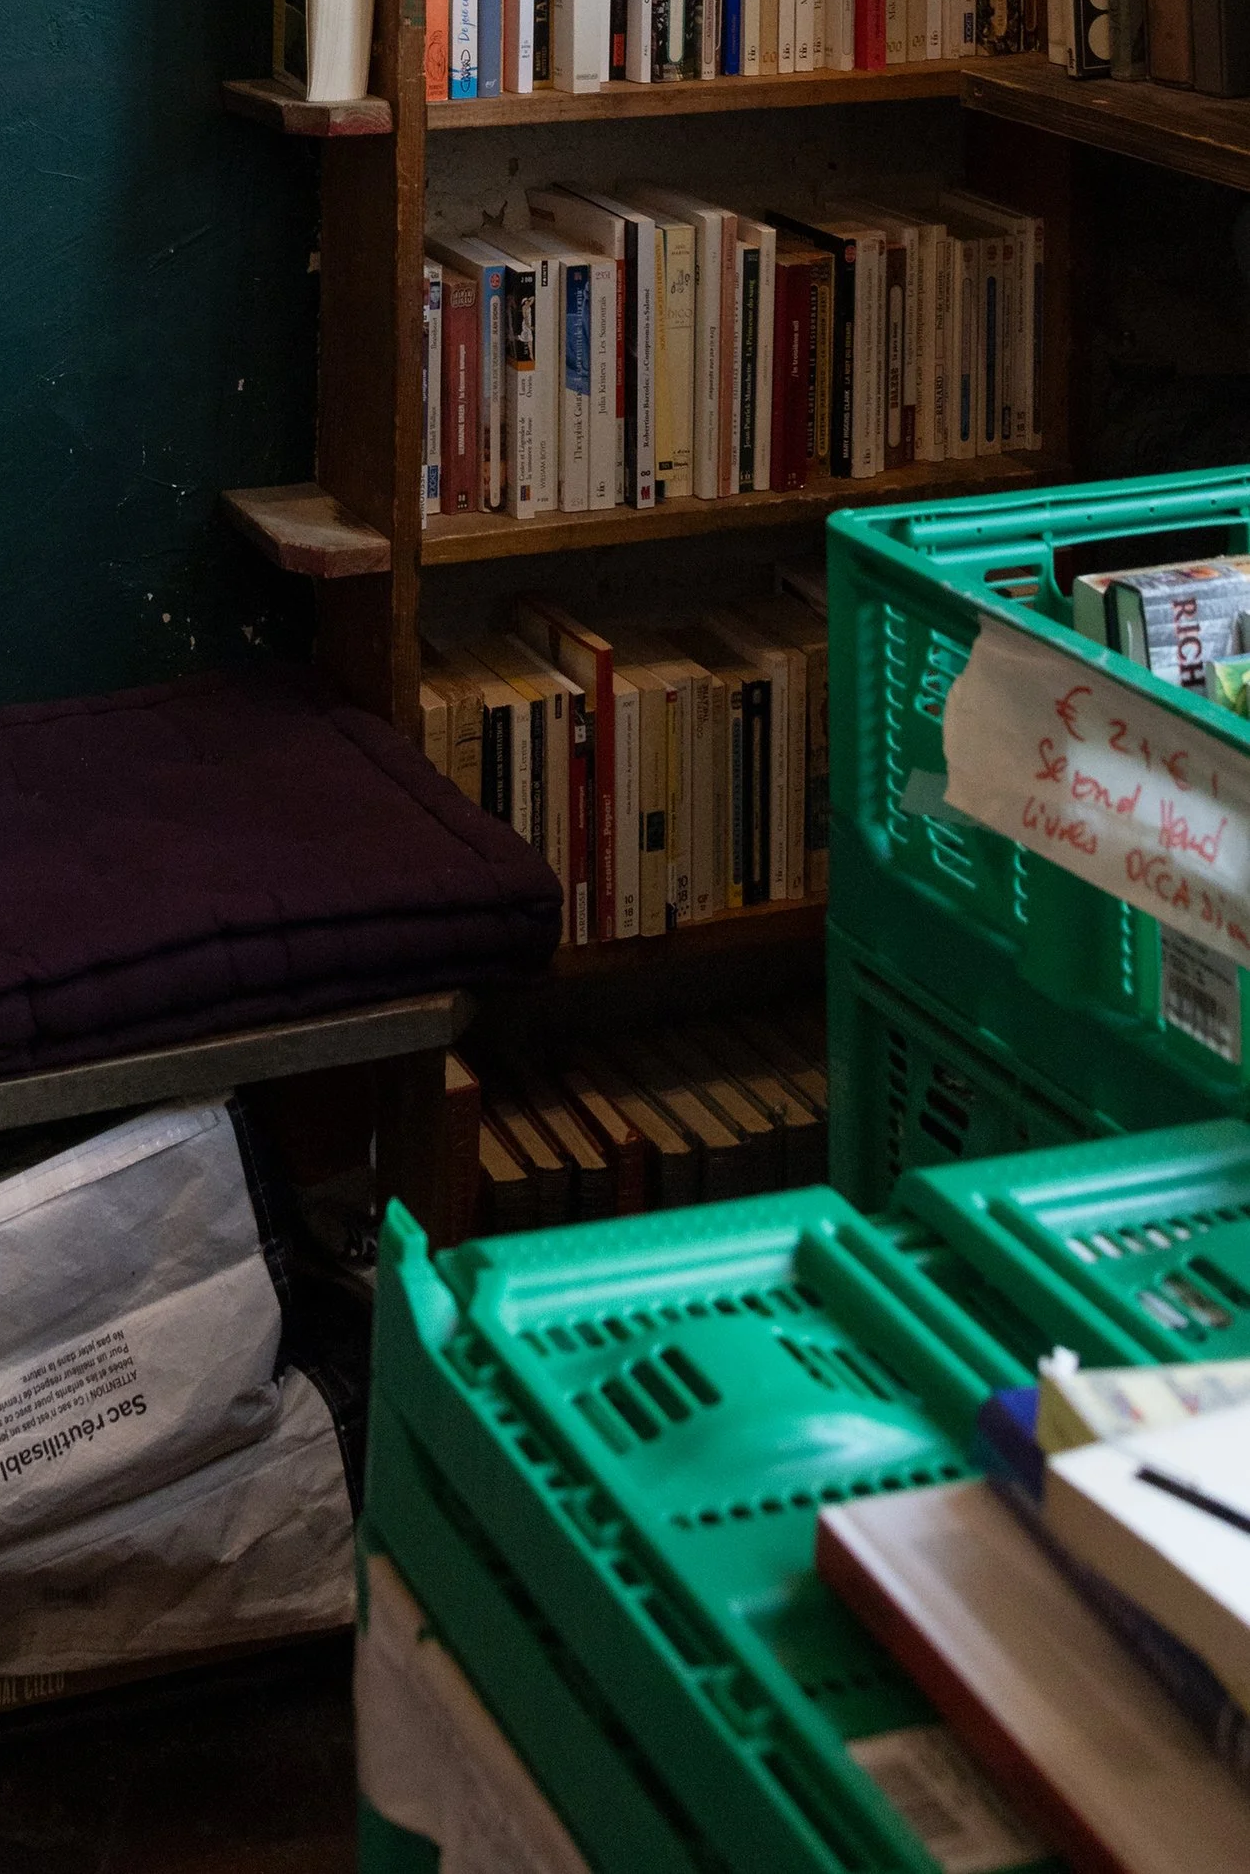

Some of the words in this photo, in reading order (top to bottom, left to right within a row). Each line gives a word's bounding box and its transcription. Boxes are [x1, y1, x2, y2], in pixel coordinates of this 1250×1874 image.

[535, 4, 548, 24] LA
[1173, 596, 1206, 687] RICH
[78, 1340, 95, 1357] jeter
[96, 1333, 111, 1348] pas
[56, 1351, 76, 1366] dans
[106, 1392, 148, 1424] Sac
